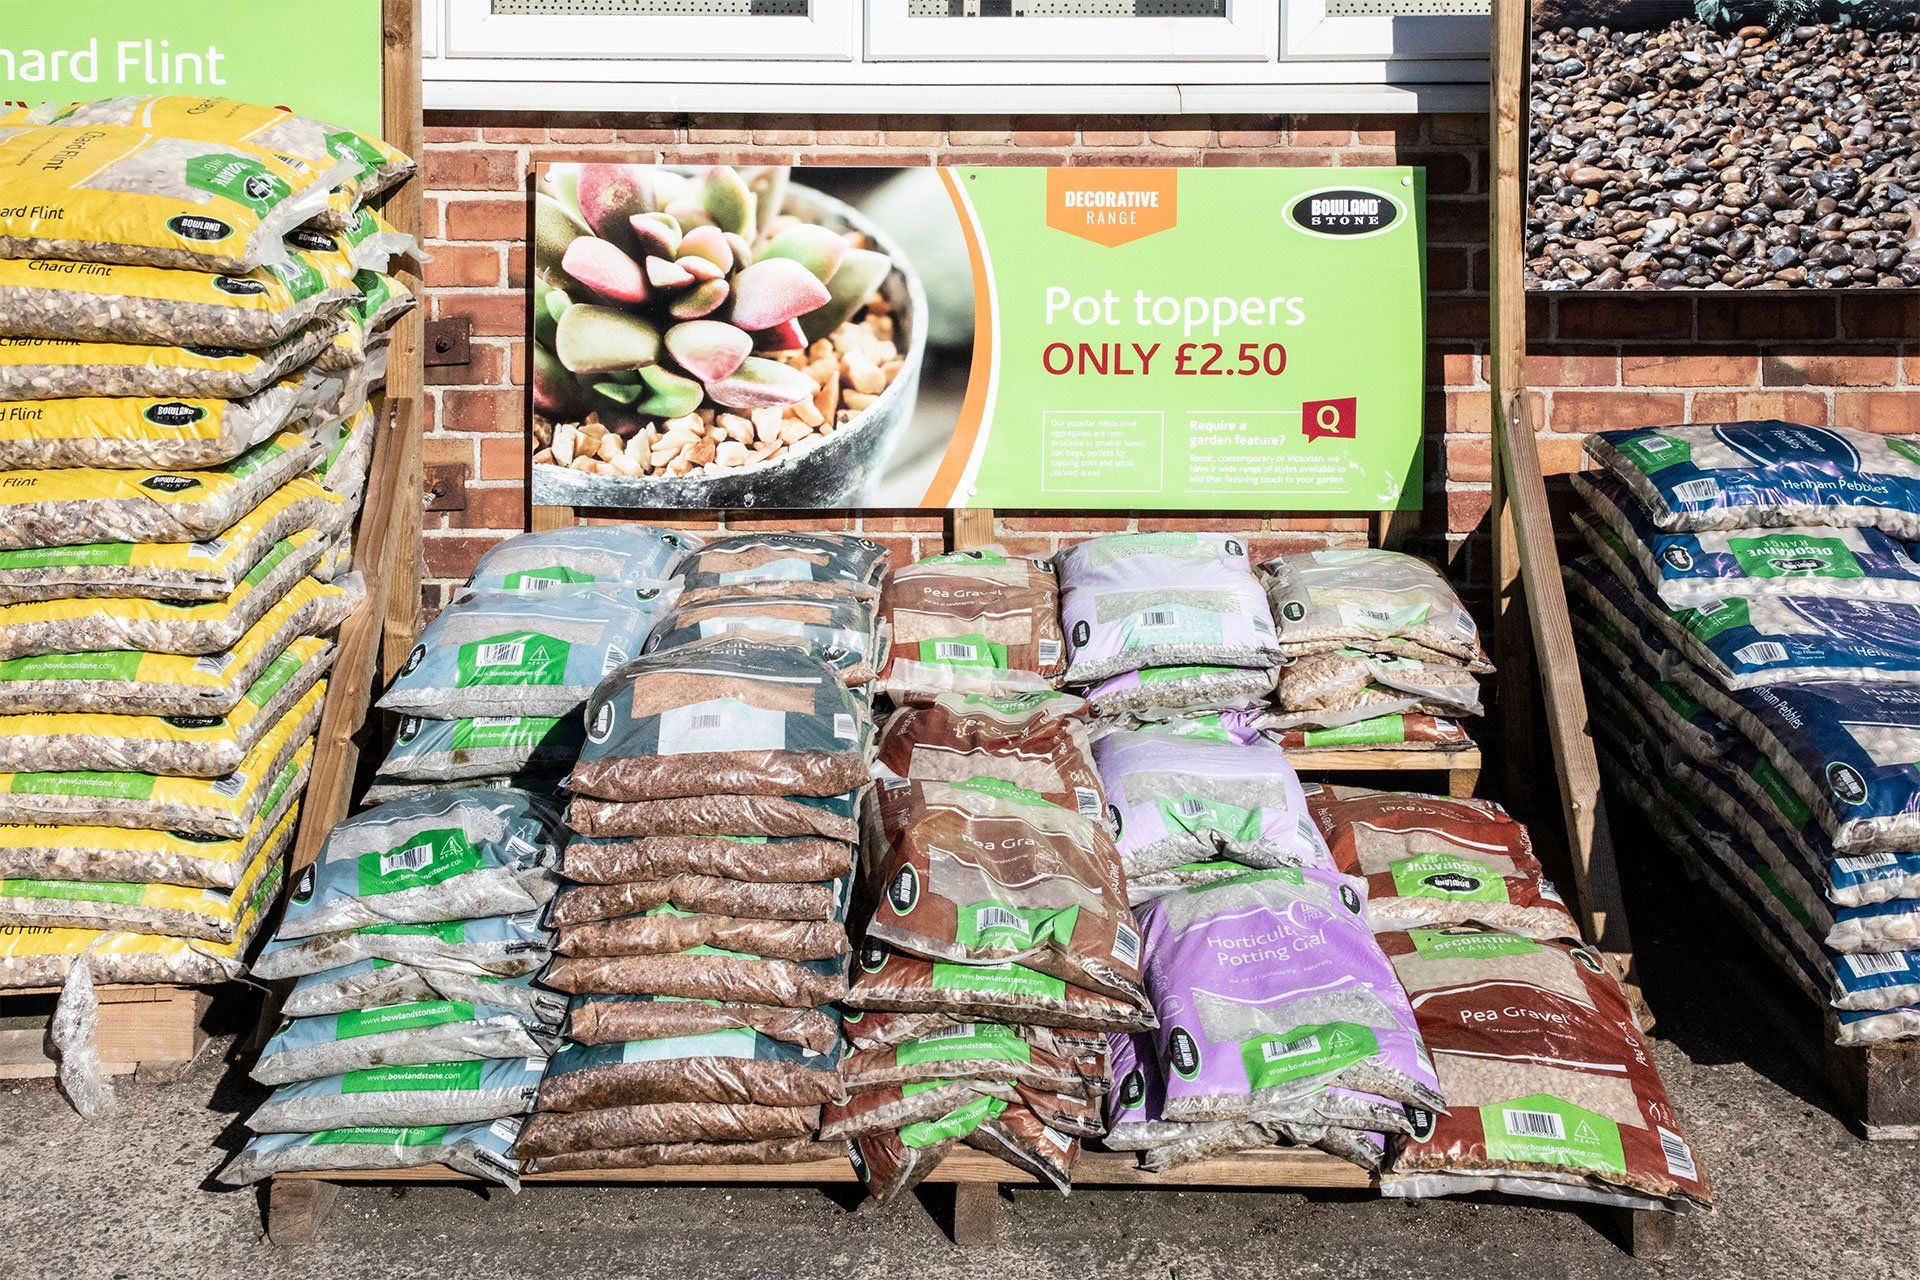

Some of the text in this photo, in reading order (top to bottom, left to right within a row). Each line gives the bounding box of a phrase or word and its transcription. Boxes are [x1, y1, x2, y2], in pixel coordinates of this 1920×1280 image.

[117, 39, 227, 86] Flint
[1065, 191, 1159, 208] DECORATIVE
[30, 206, 65, 220] Flint
[1311, 199, 1379, 216] BOWLAND
[1086, 211, 1138, 225] RANGE
[1311, 216, 1379, 225] STONE
[181, 218, 221, 232] BOWLAND
[28, 260, 113, 276] Chard Flint
[1045, 286, 1305, 337] Pot toppers
[1042, 342, 1287, 376] ONLY £2.50
[10, 407, 43, 420] Flint
[158, 406, 194, 416] BOWLAND
[1067, 420, 1096, 428] popular
[1316, 405, 1340, 433] Q
[1190, 420, 1235, 432] Require
[1189, 434, 1286, 447] garden feature?
[1189, 455, 1216, 463] Rustic,
[1218, 455, 1274, 464] contemporary
[1189, 465, 1208, 473] have
[1218, 465, 1237, 473] wide
[1239, 466, 1262, 475] range
[1264, 465, 1273, 473] of
[1274, 465, 1297, 475] styles
[1299, 465, 1335, 473] available
[4, 478, 39, 487] Flint
[1224, 476, 1258, 485] finishing
[1296, 477, 1316, 485] your
[1316, 476, 1346, 485] garden.
[1782, 479, 1888, 494] Henham Pebbles
[17, 549, 109, 559] www.bowlandstone.com
[1749, 546, 1834, 557] DECORATIVE
[924, 587, 949, 598] Pea
[22, 662, 117, 673] www.bowlandstone.com
[1776, 702, 1804, 729] Pebbles
[37, 777, 133, 787] www.bowlandstone.com
[1407, 862, 1486, 874] DECORATIVE
[899, 872, 912, 904] BOWLAND
[1457, 944, 1504, 953] RANGE
[1217, 946, 1291, 966] Potting
[1303, 960, 1333, 972] naturally
[955, 973, 1045, 986] www.bowlandstone.com
[360, 1004, 454, 1026] www.bowlandstone.com
[1460, 1006, 1570, 1026] Pea Gravel
[1176, 1034, 1193, 1067] BOWLAND
[1269, 1050, 1359, 1075] www.bowlandstone.com
[367, 1072, 461, 1081] www.bowlandstone.com
[1574, 1138, 1601, 1146] HEAVY
[1509, 1142, 1604, 1159] www.bowlandstone.com
